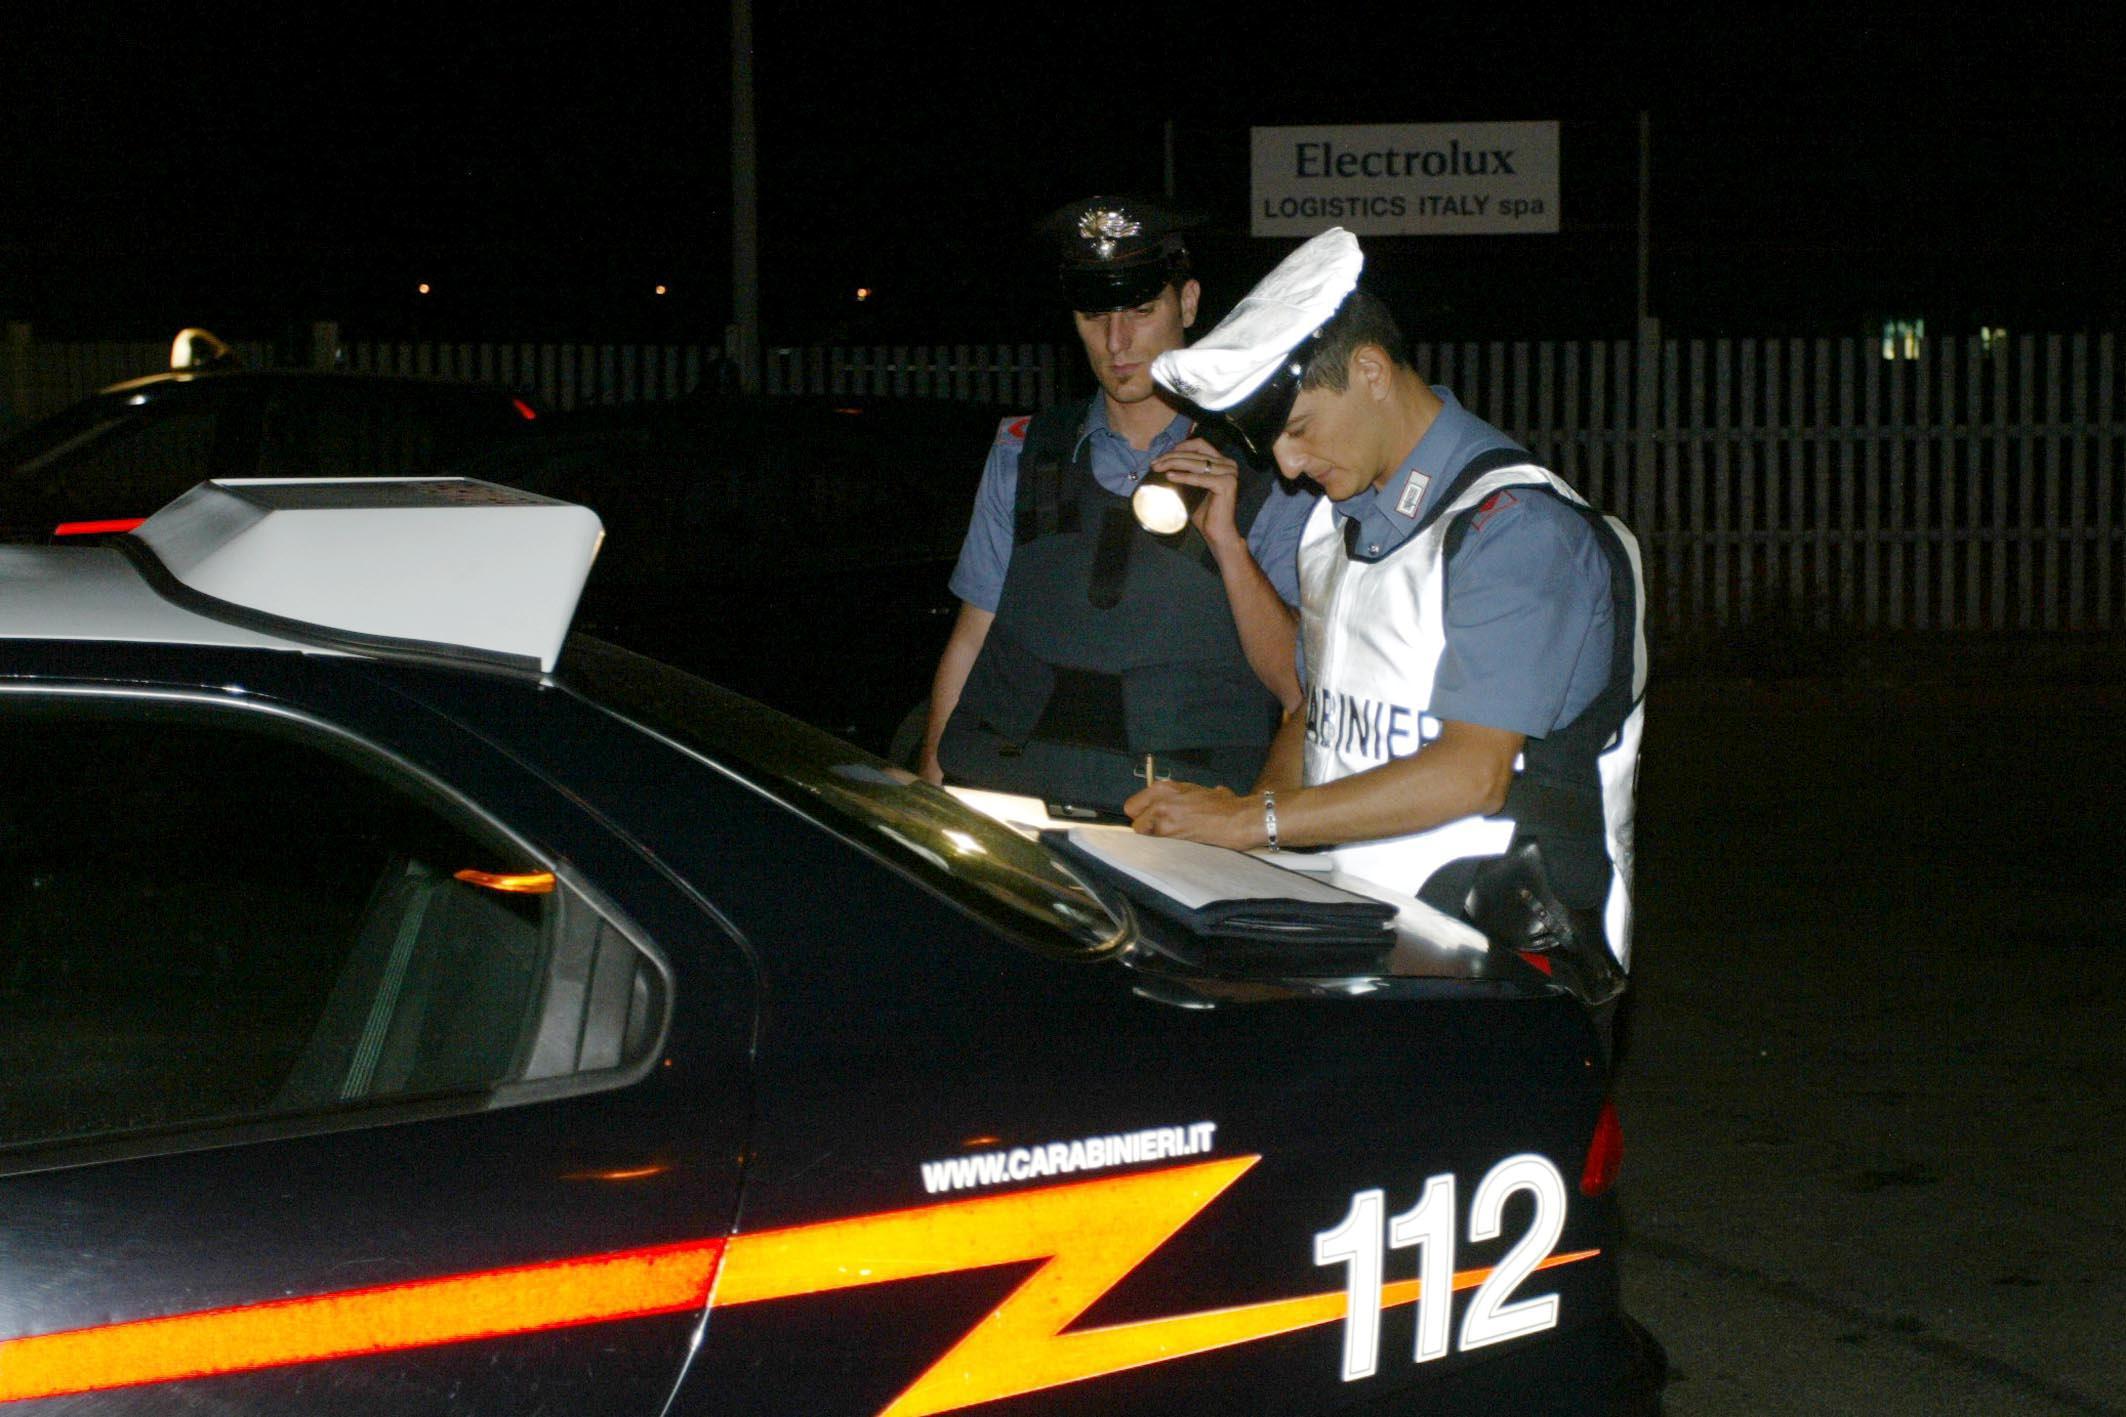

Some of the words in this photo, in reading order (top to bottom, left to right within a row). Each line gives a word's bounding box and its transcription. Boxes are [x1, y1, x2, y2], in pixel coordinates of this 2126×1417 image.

[1295, 140, 1517, 179] Electrolux
[1263, 195, 1407, 219] LOGISTICS
[1418, 195, 1490, 217] ITALY
[1499, 197, 1545, 220] spa
[921, 1121, 1217, 1194] WWW.CARABINIERI.IT
[1313, 1152, 1568, 1382] 112
